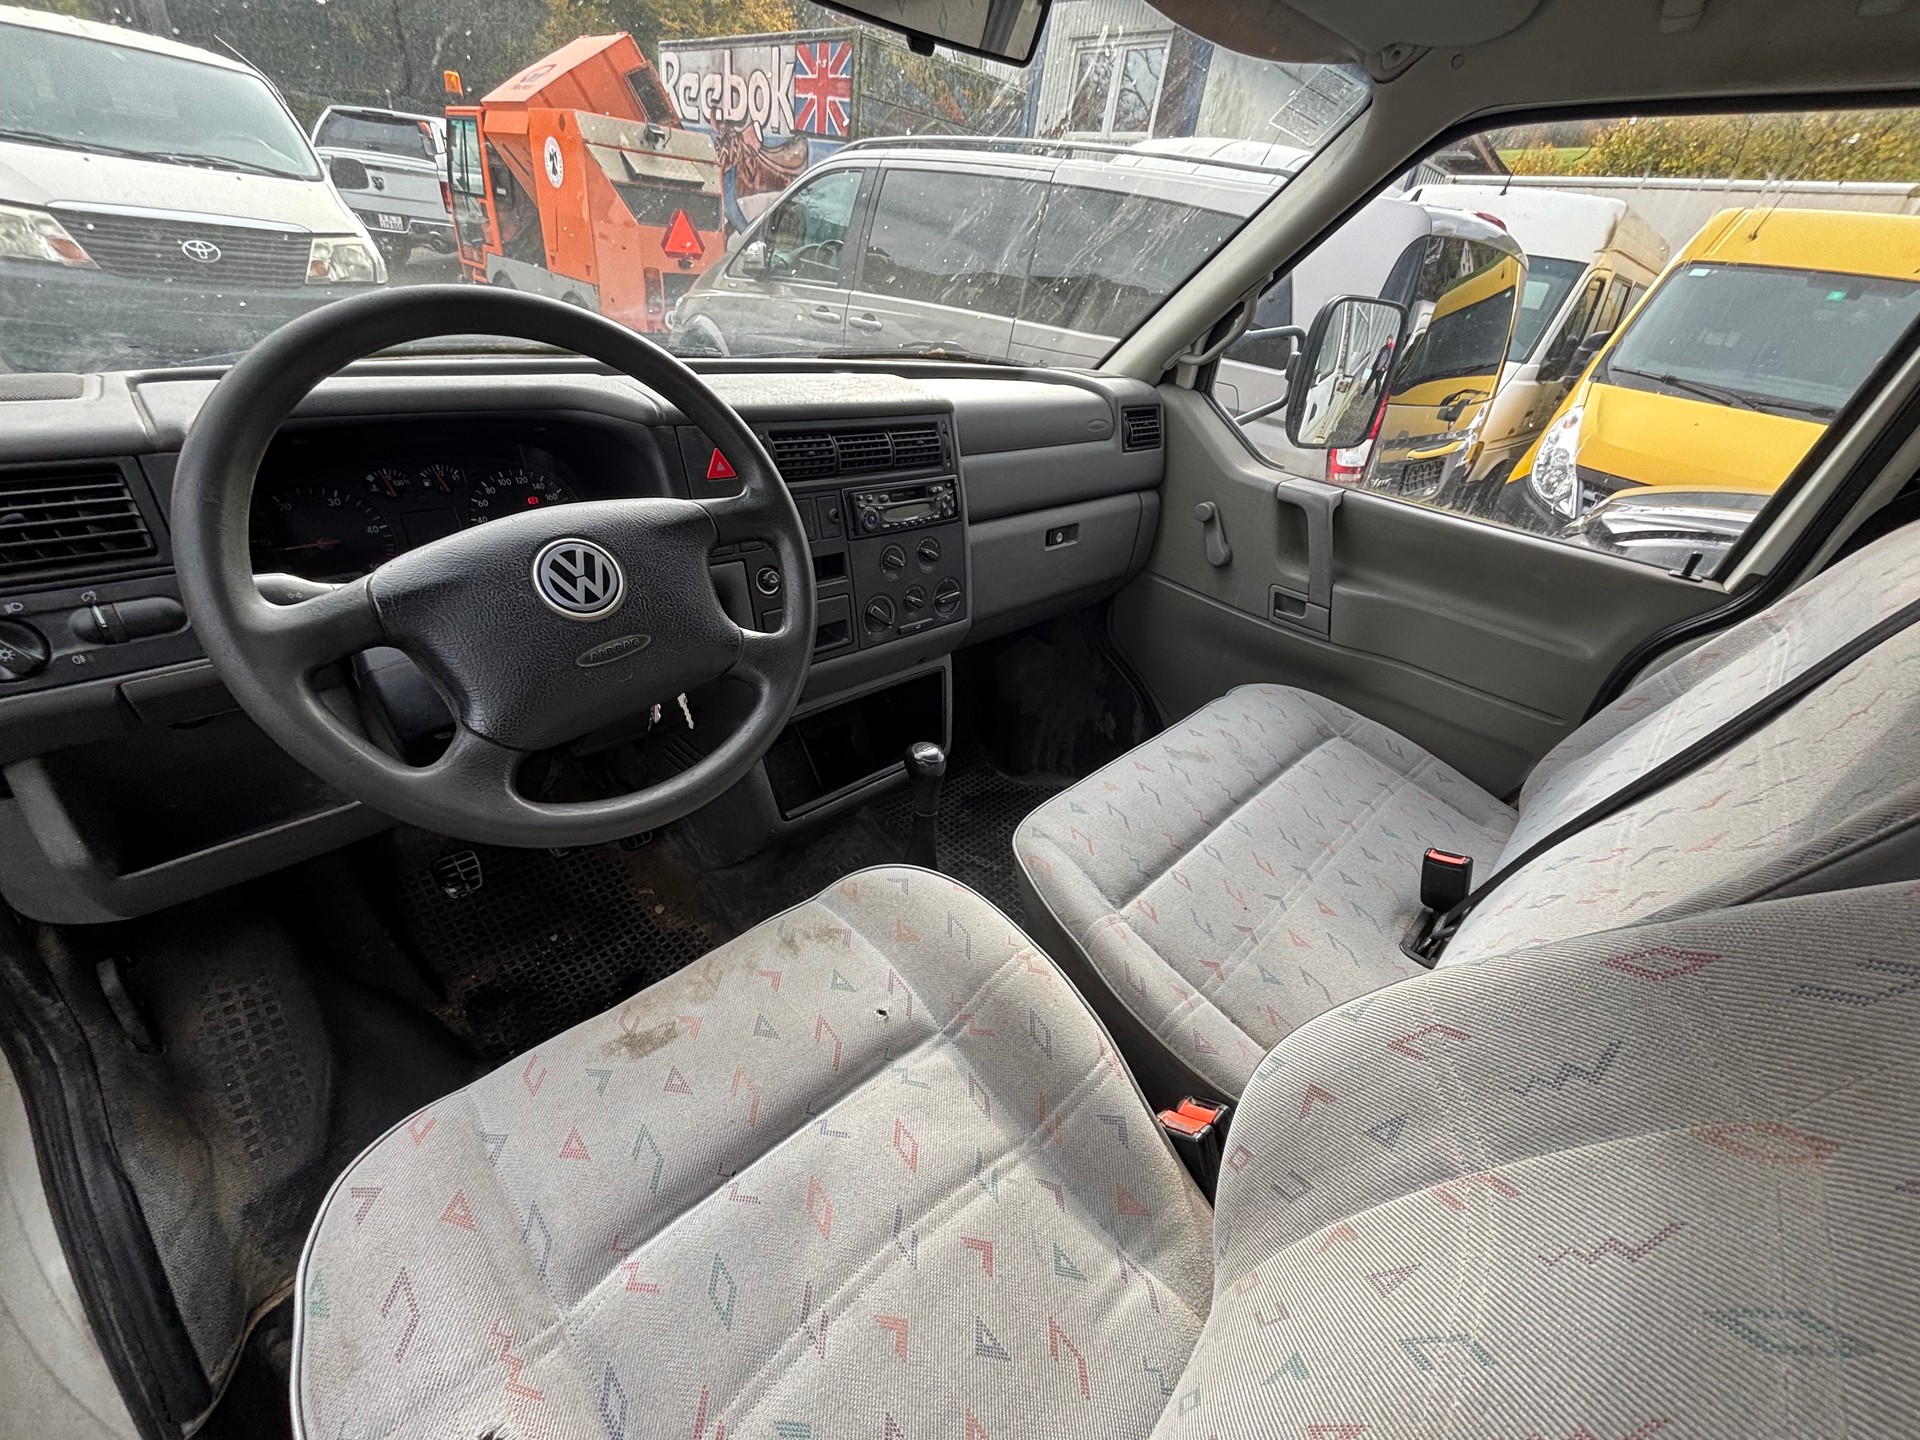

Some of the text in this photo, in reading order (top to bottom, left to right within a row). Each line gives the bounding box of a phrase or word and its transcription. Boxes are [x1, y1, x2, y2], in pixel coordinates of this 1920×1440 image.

[498, 478, 512, 487] 100
[515, 476, 529, 485] 120
[485, 486, 497, 495] 80
[532, 482, 546, 490] 140
[545, 493, 559, 501] 160
[278, 501, 293, 511] 20
[327, 497, 342, 507] 30
[477, 499, 489, 508] 60
[477, 516, 488, 524] 40
[366, 524, 380, 534] 40
[591, 638, 640, 661] AIRBAG
